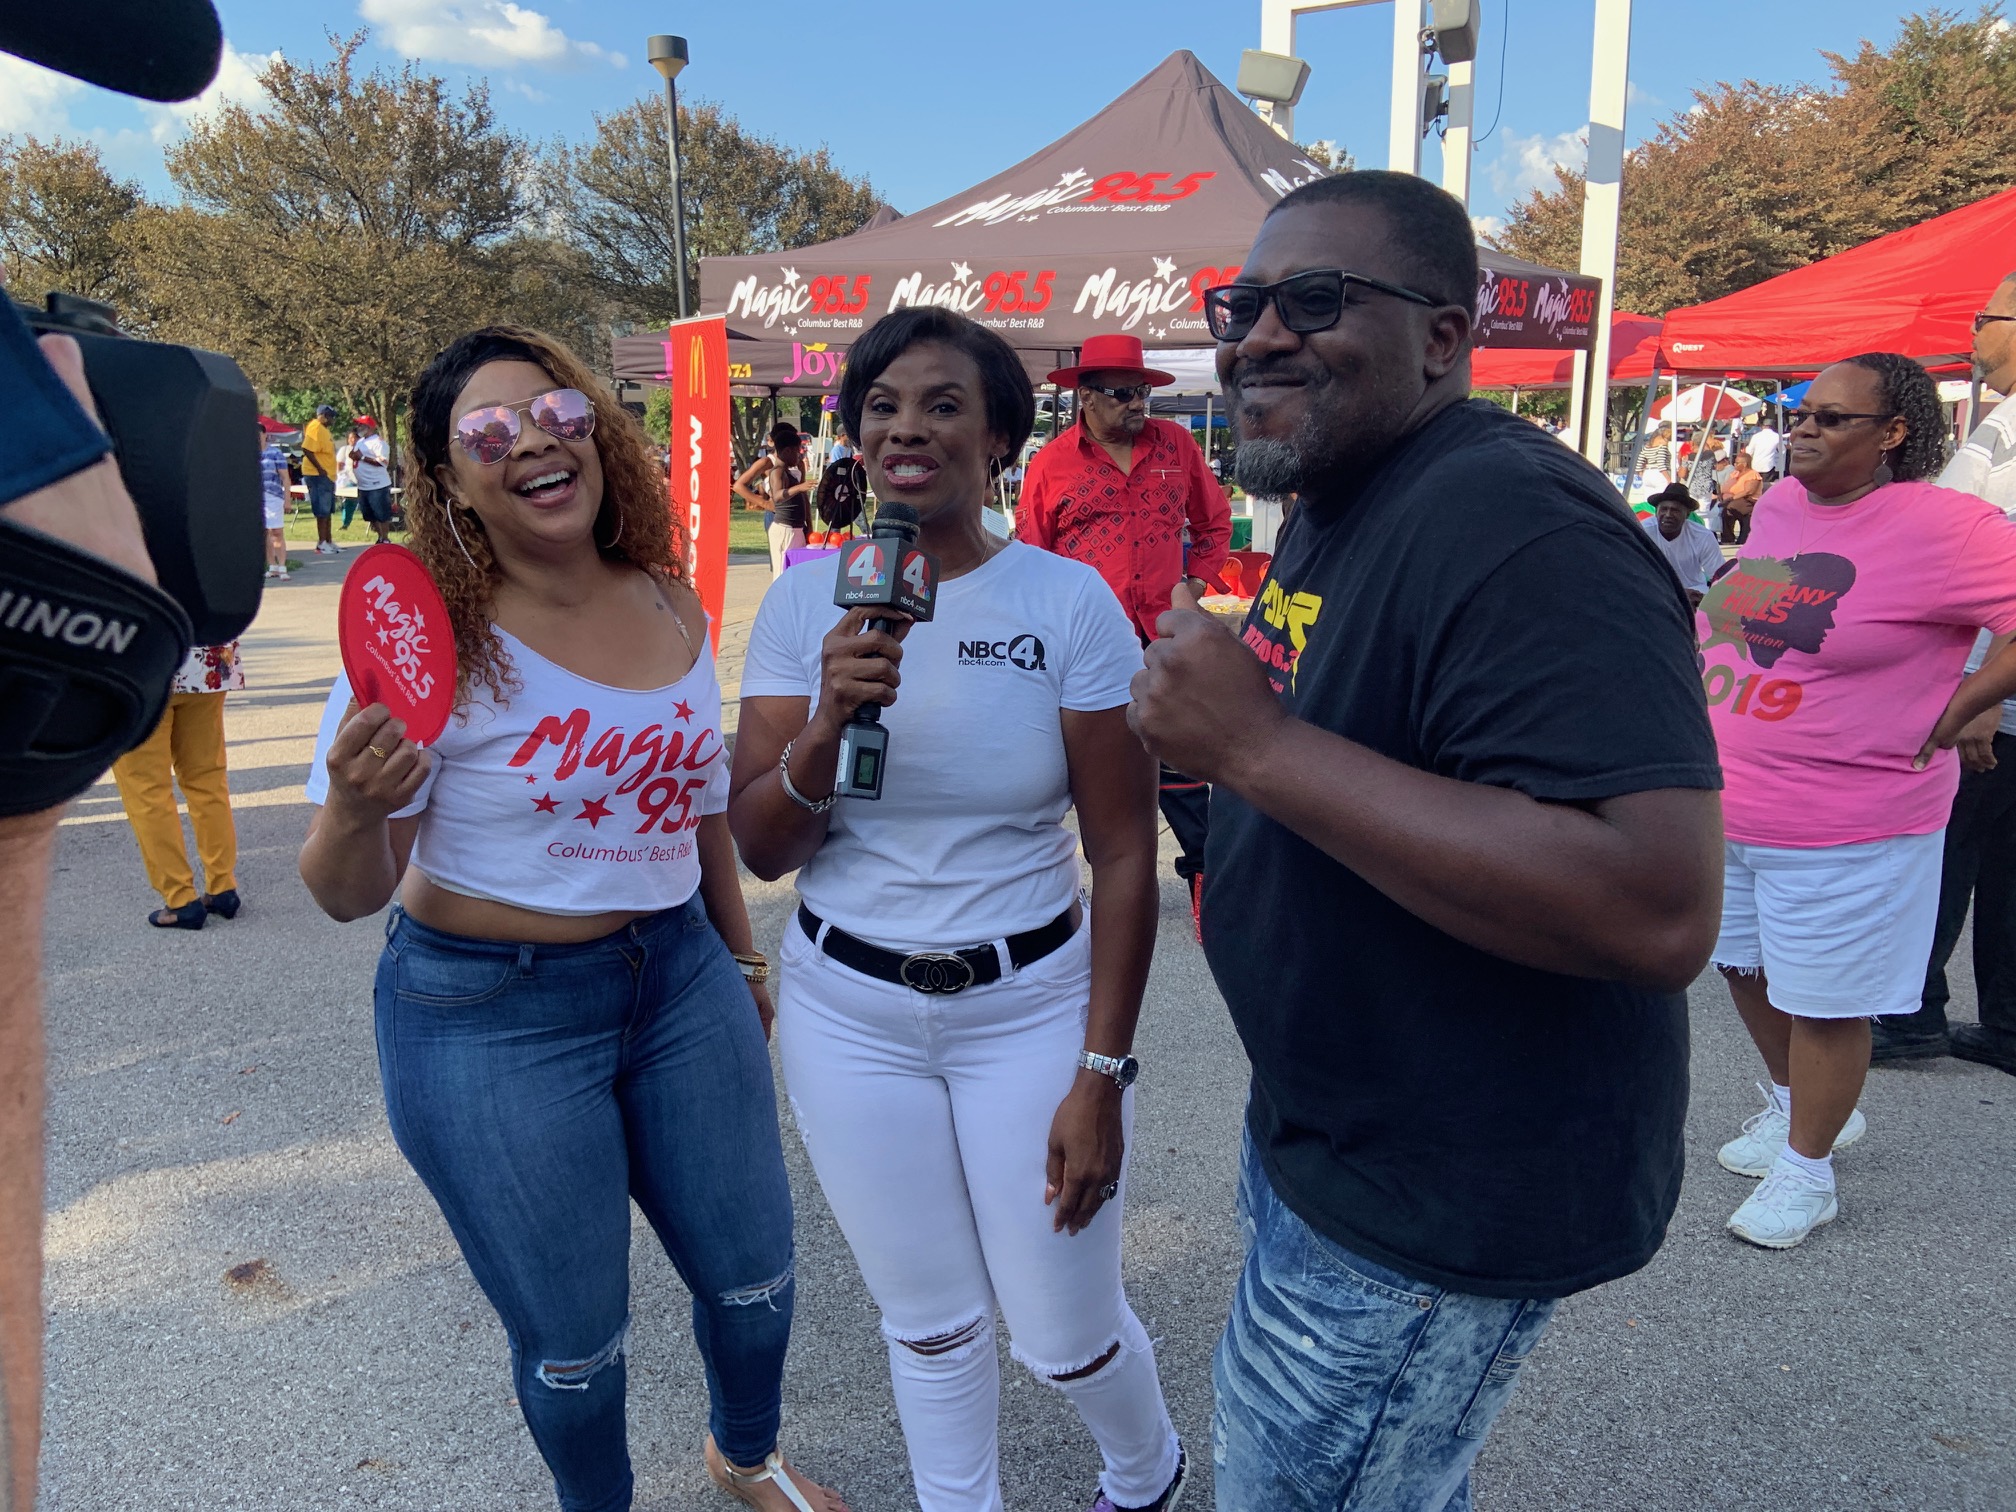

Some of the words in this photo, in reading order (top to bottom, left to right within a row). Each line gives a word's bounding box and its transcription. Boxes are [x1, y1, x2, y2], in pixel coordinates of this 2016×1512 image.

[932, 179, 1094, 227] Magic
[1080, 171, 1217, 202] 95.5
[1113, 204, 1141, 213] Best
[727, 275, 812, 329] Magic
[809, 275, 871, 315] 95.5
[983, 270, 1056, 313] 95.5
[1072, 267, 1192, 331] Magic
[1498, 277, 1529, 318] 95.5
[1533, 282, 1572, 335] Magic
[1570, 288, 1595, 324] 95.5
[797, 318, 833, 329] Columbus'
[833, 318, 848, 328] Best
[848, 318, 863, 328] R&B
[1009, 318, 1027, 328] Best
[1027, 318, 1045, 329] R&B
[783, 342, 844, 387] Joy
[848, 545, 877, 586] 4
[902, 554, 925, 598] 4
[1722, 589, 1795, 624] HILLS
[1725, 571, 1837, 606] BRITTANY
[362, 575, 431, 653] Magic
[1721, 618, 1786, 649] Reunion
[365, 640, 397, 678] Columbus'
[394, 675, 407, 694] Best
[392, 640, 435, 699] 95.5
[958, 641, 1007, 659] NBC
[1010, 636, 1038, 670] 4
[958, 658, 1006, 667] nbc4i.com
[1700, 664, 1803, 722] 019
[507, 708, 722, 795] Magic
[634, 777, 707, 834] 95.
[547, 842, 649, 863] Columbus'
[649, 845, 676, 862] Best
